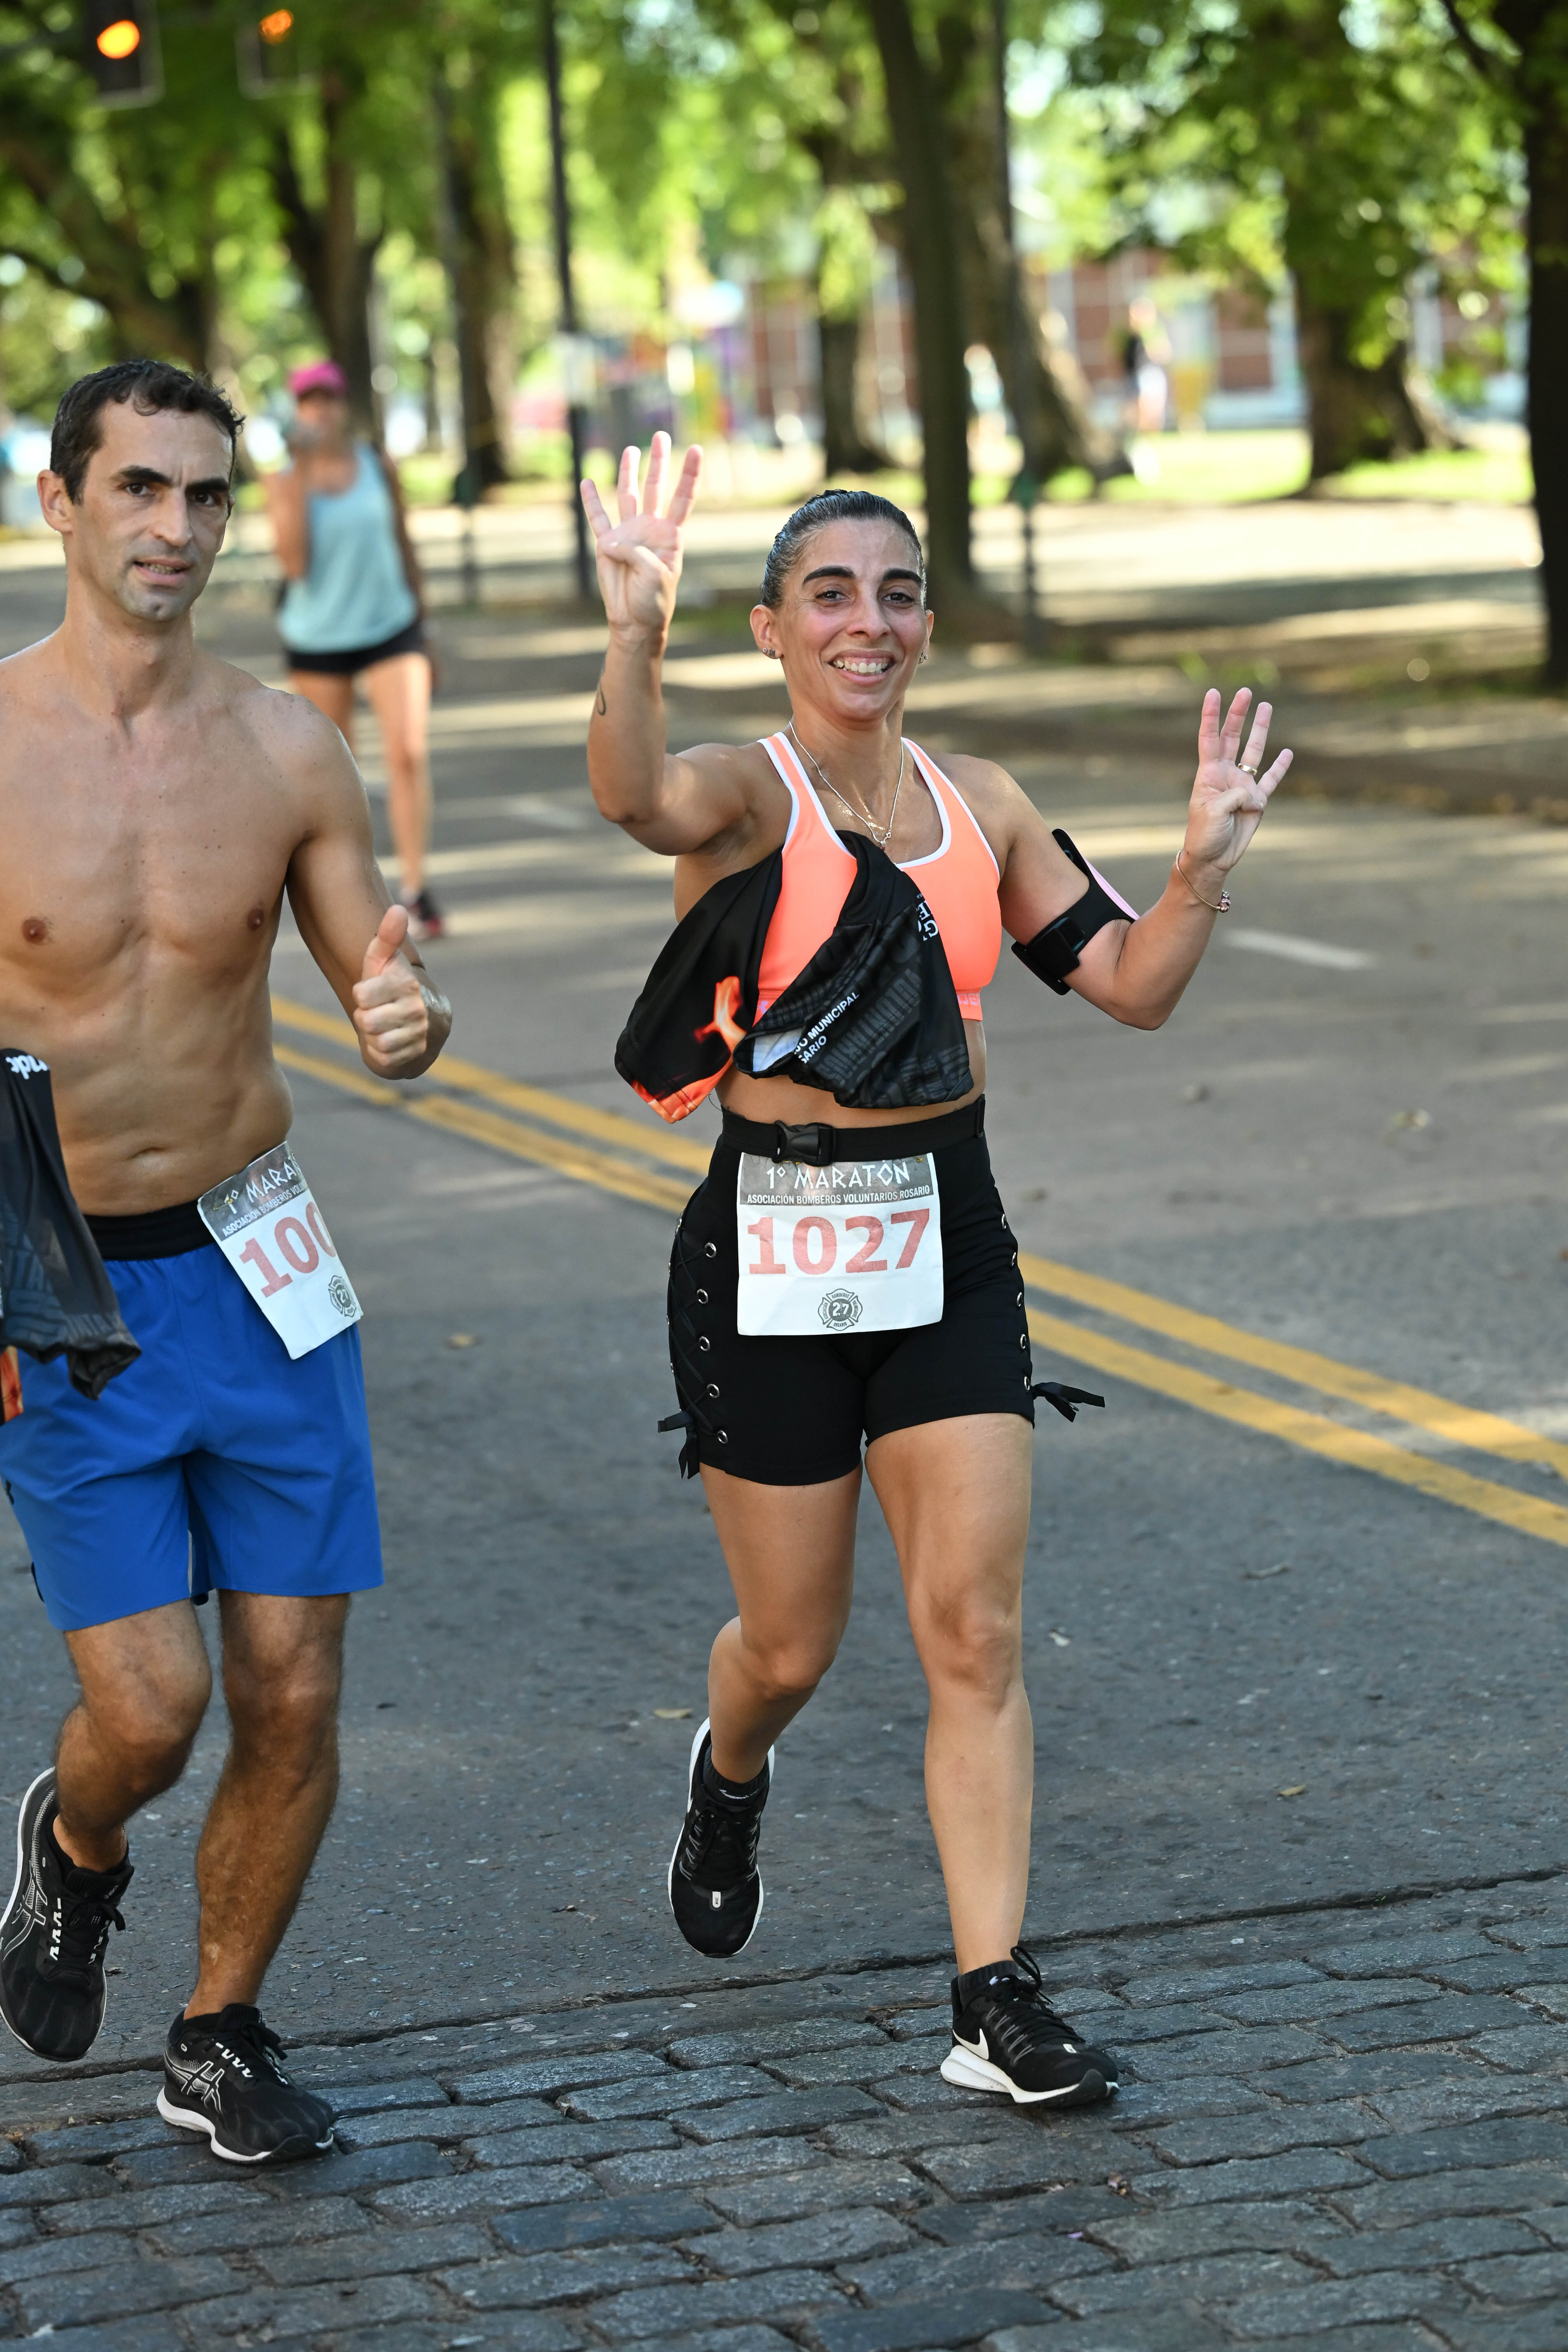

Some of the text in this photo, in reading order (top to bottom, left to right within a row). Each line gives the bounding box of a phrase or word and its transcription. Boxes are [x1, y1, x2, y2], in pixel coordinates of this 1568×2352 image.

[807, 992, 859, 1039] MUNICIPAL
[794, 1160, 910, 1189] MARATÓN
[259, 1188, 292, 1220] BOMBEROS
[747, 1185, 930, 1204] ASOCIACIÓN BOMBEROS VOLUNTARIOS ROSARIO
[747, 1208, 929, 1275] 1027
[832, 1302, 849, 1316] 27
